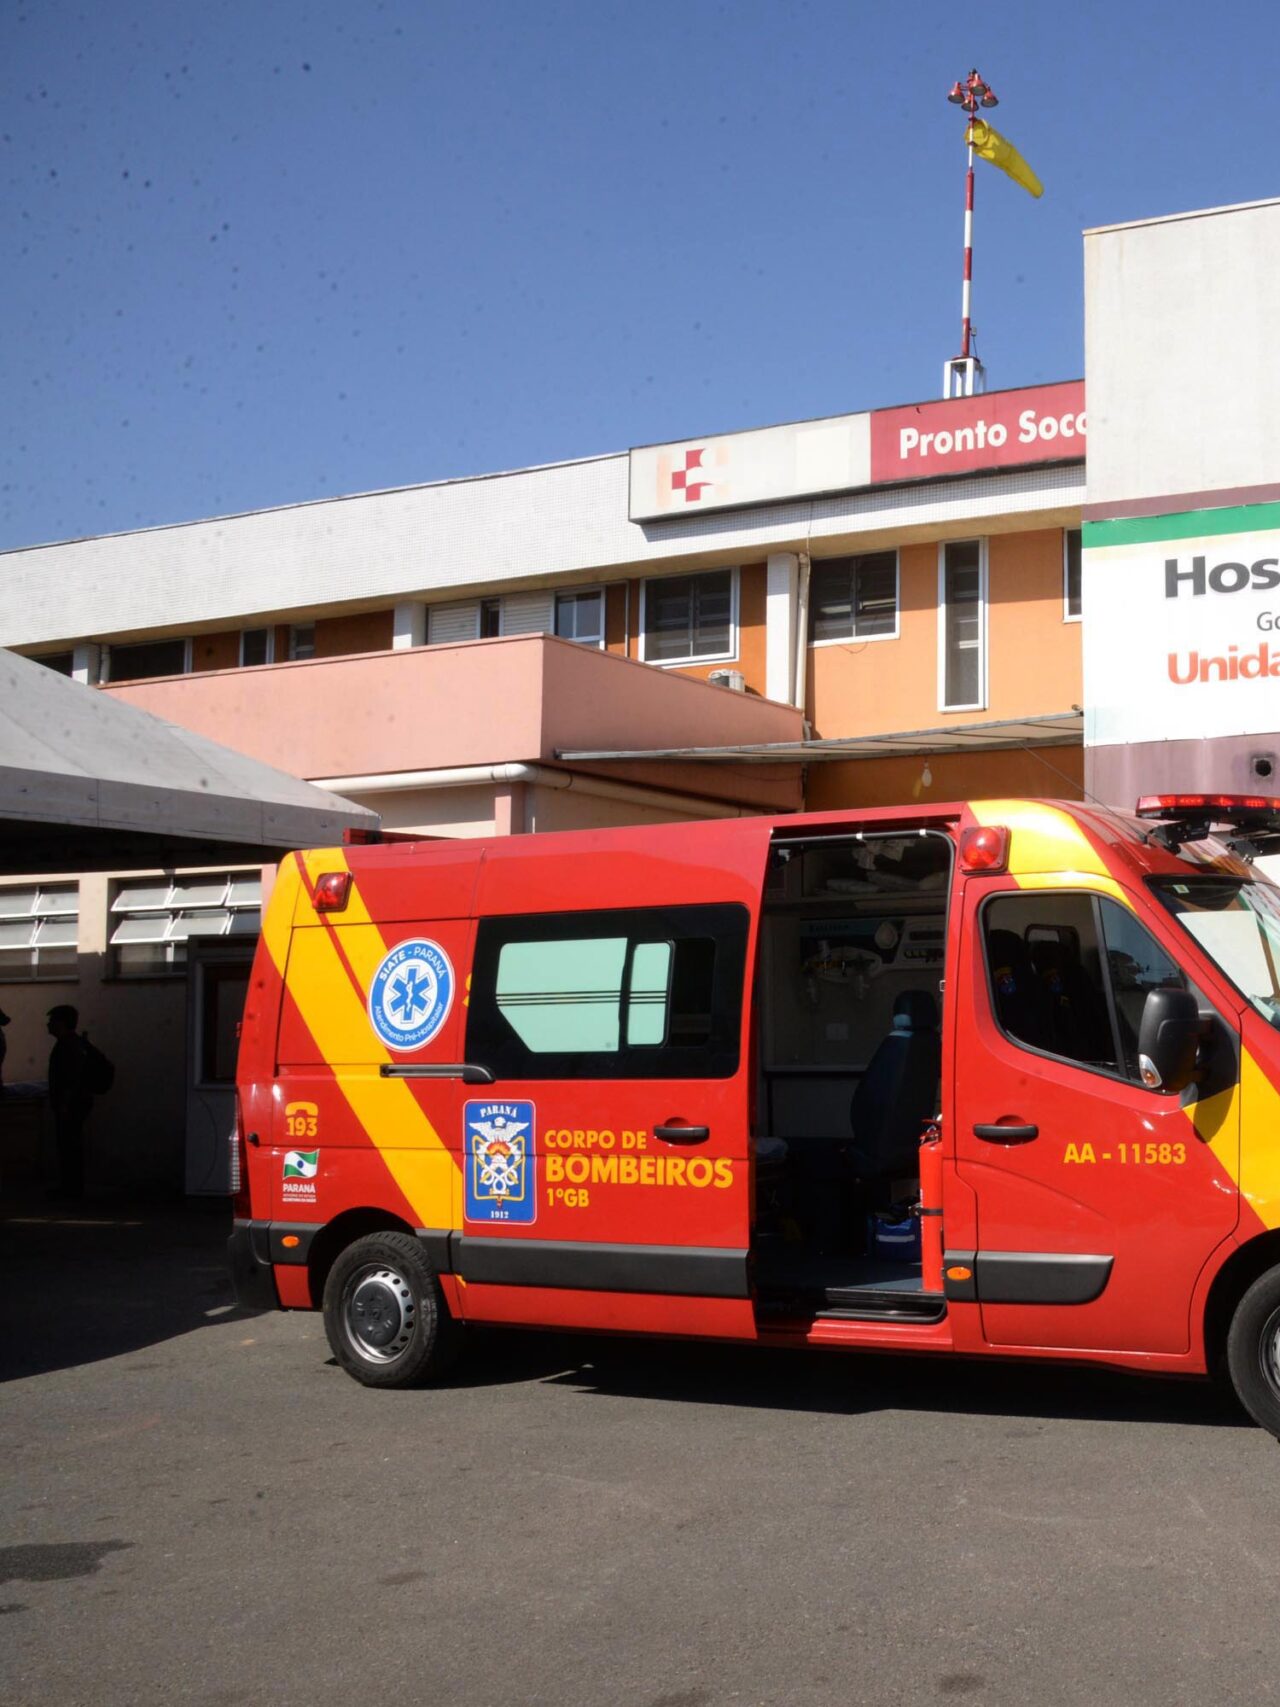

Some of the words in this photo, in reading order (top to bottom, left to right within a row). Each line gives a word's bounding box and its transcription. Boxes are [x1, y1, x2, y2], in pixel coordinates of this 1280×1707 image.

[900, 421, 1006, 459] Pronto
[379, 950, 406, 981] SIATE
[413, 946, 448, 979] PARANÁ
[480, 1105, 517, 1119] PARANÁ
[287, 1117, 318, 1137] 193
[544, 1130, 615, 1149] CORPO
[623, 1131, 647, 1150] DE
[1063, 1142, 1095, 1164] AA
[1117, 1142, 1186, 1164] 11583
[545, 1154, 734, 1188] BOMBEIROS
[282, 1183, 316, 1193] PARANÁ
[490, 1210, 509, 1219] 1912
